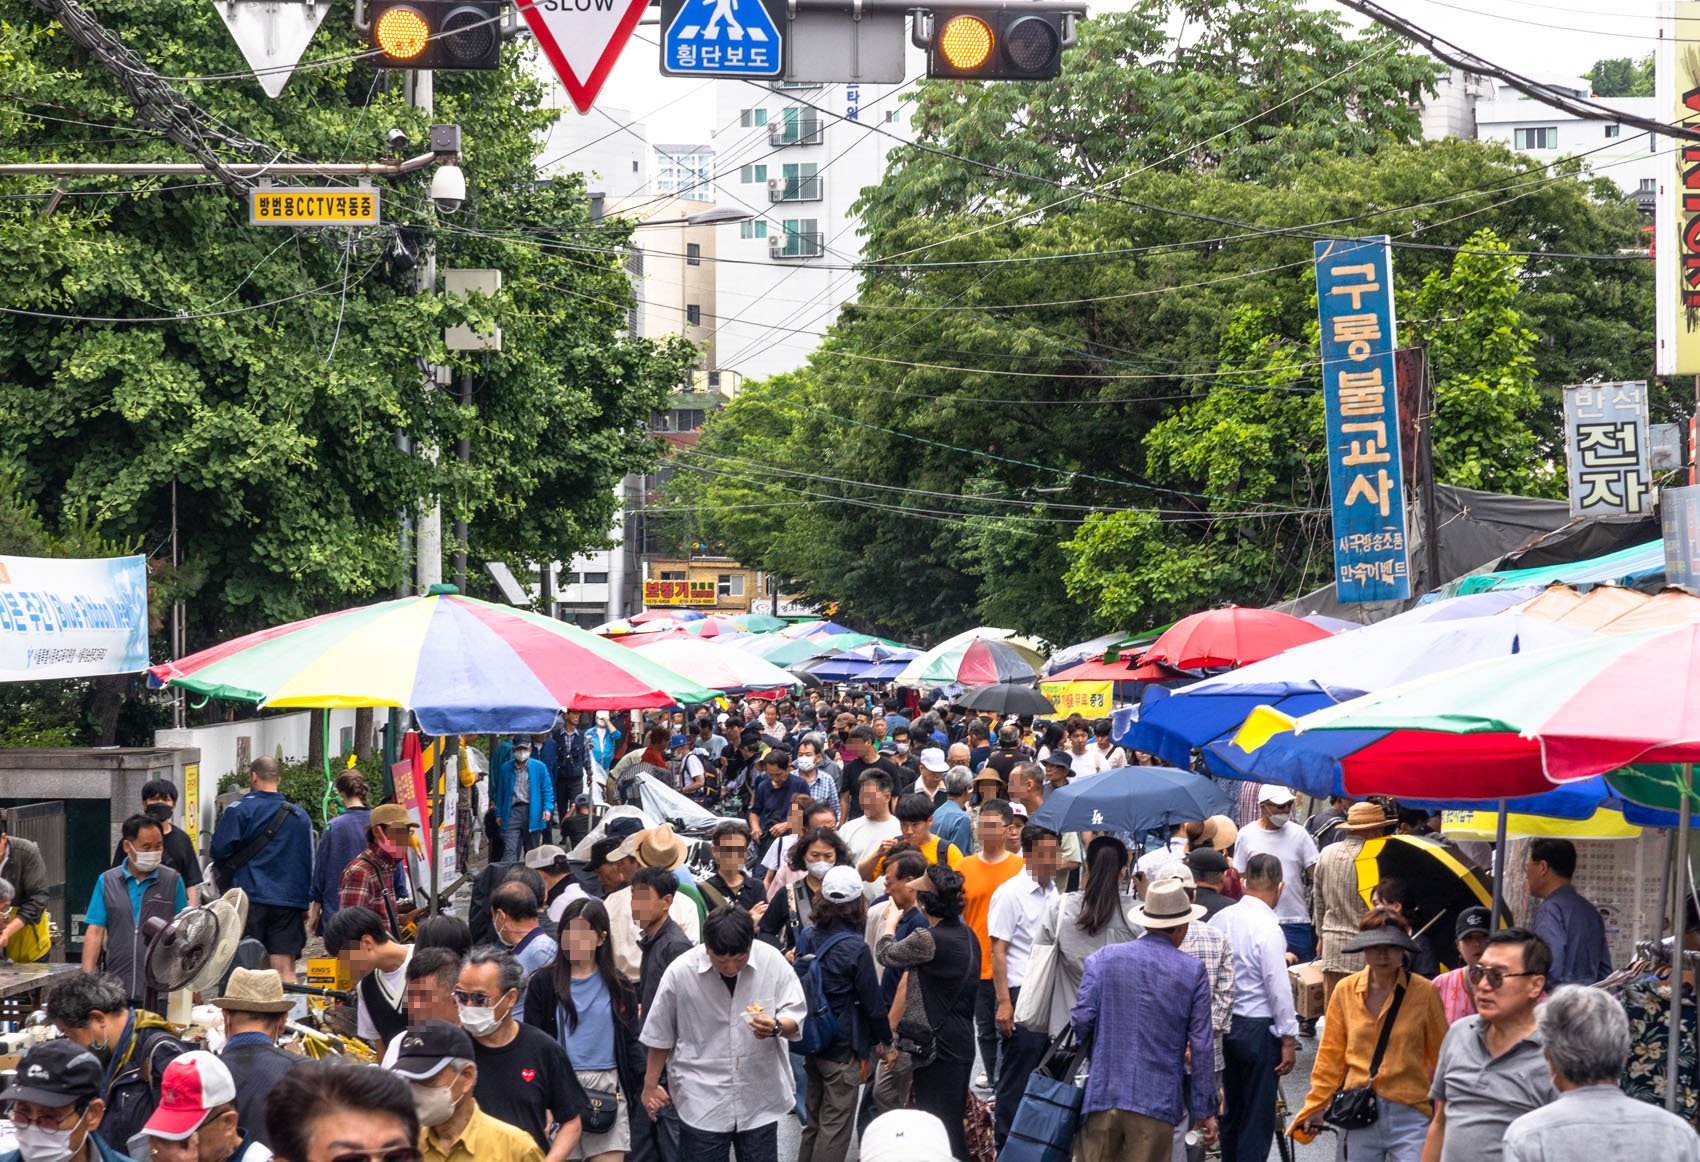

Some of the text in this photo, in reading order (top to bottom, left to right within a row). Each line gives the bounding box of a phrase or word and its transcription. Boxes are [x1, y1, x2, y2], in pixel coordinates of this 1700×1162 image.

[676, 45, 769, 67] 횡단보도
[259, 197, 371, 216] 방범용CCTV작동중
[1330, 262, 1394, 517] 구룡불교사
[1574, 389, 1642, 419] 반석
[1576, 421, 1649, 514] 전자
[645, 582, 689, 598] 보청기
[1089, 693, 1104, 708] 증정
[1091, 809, 1104, 825] LA
